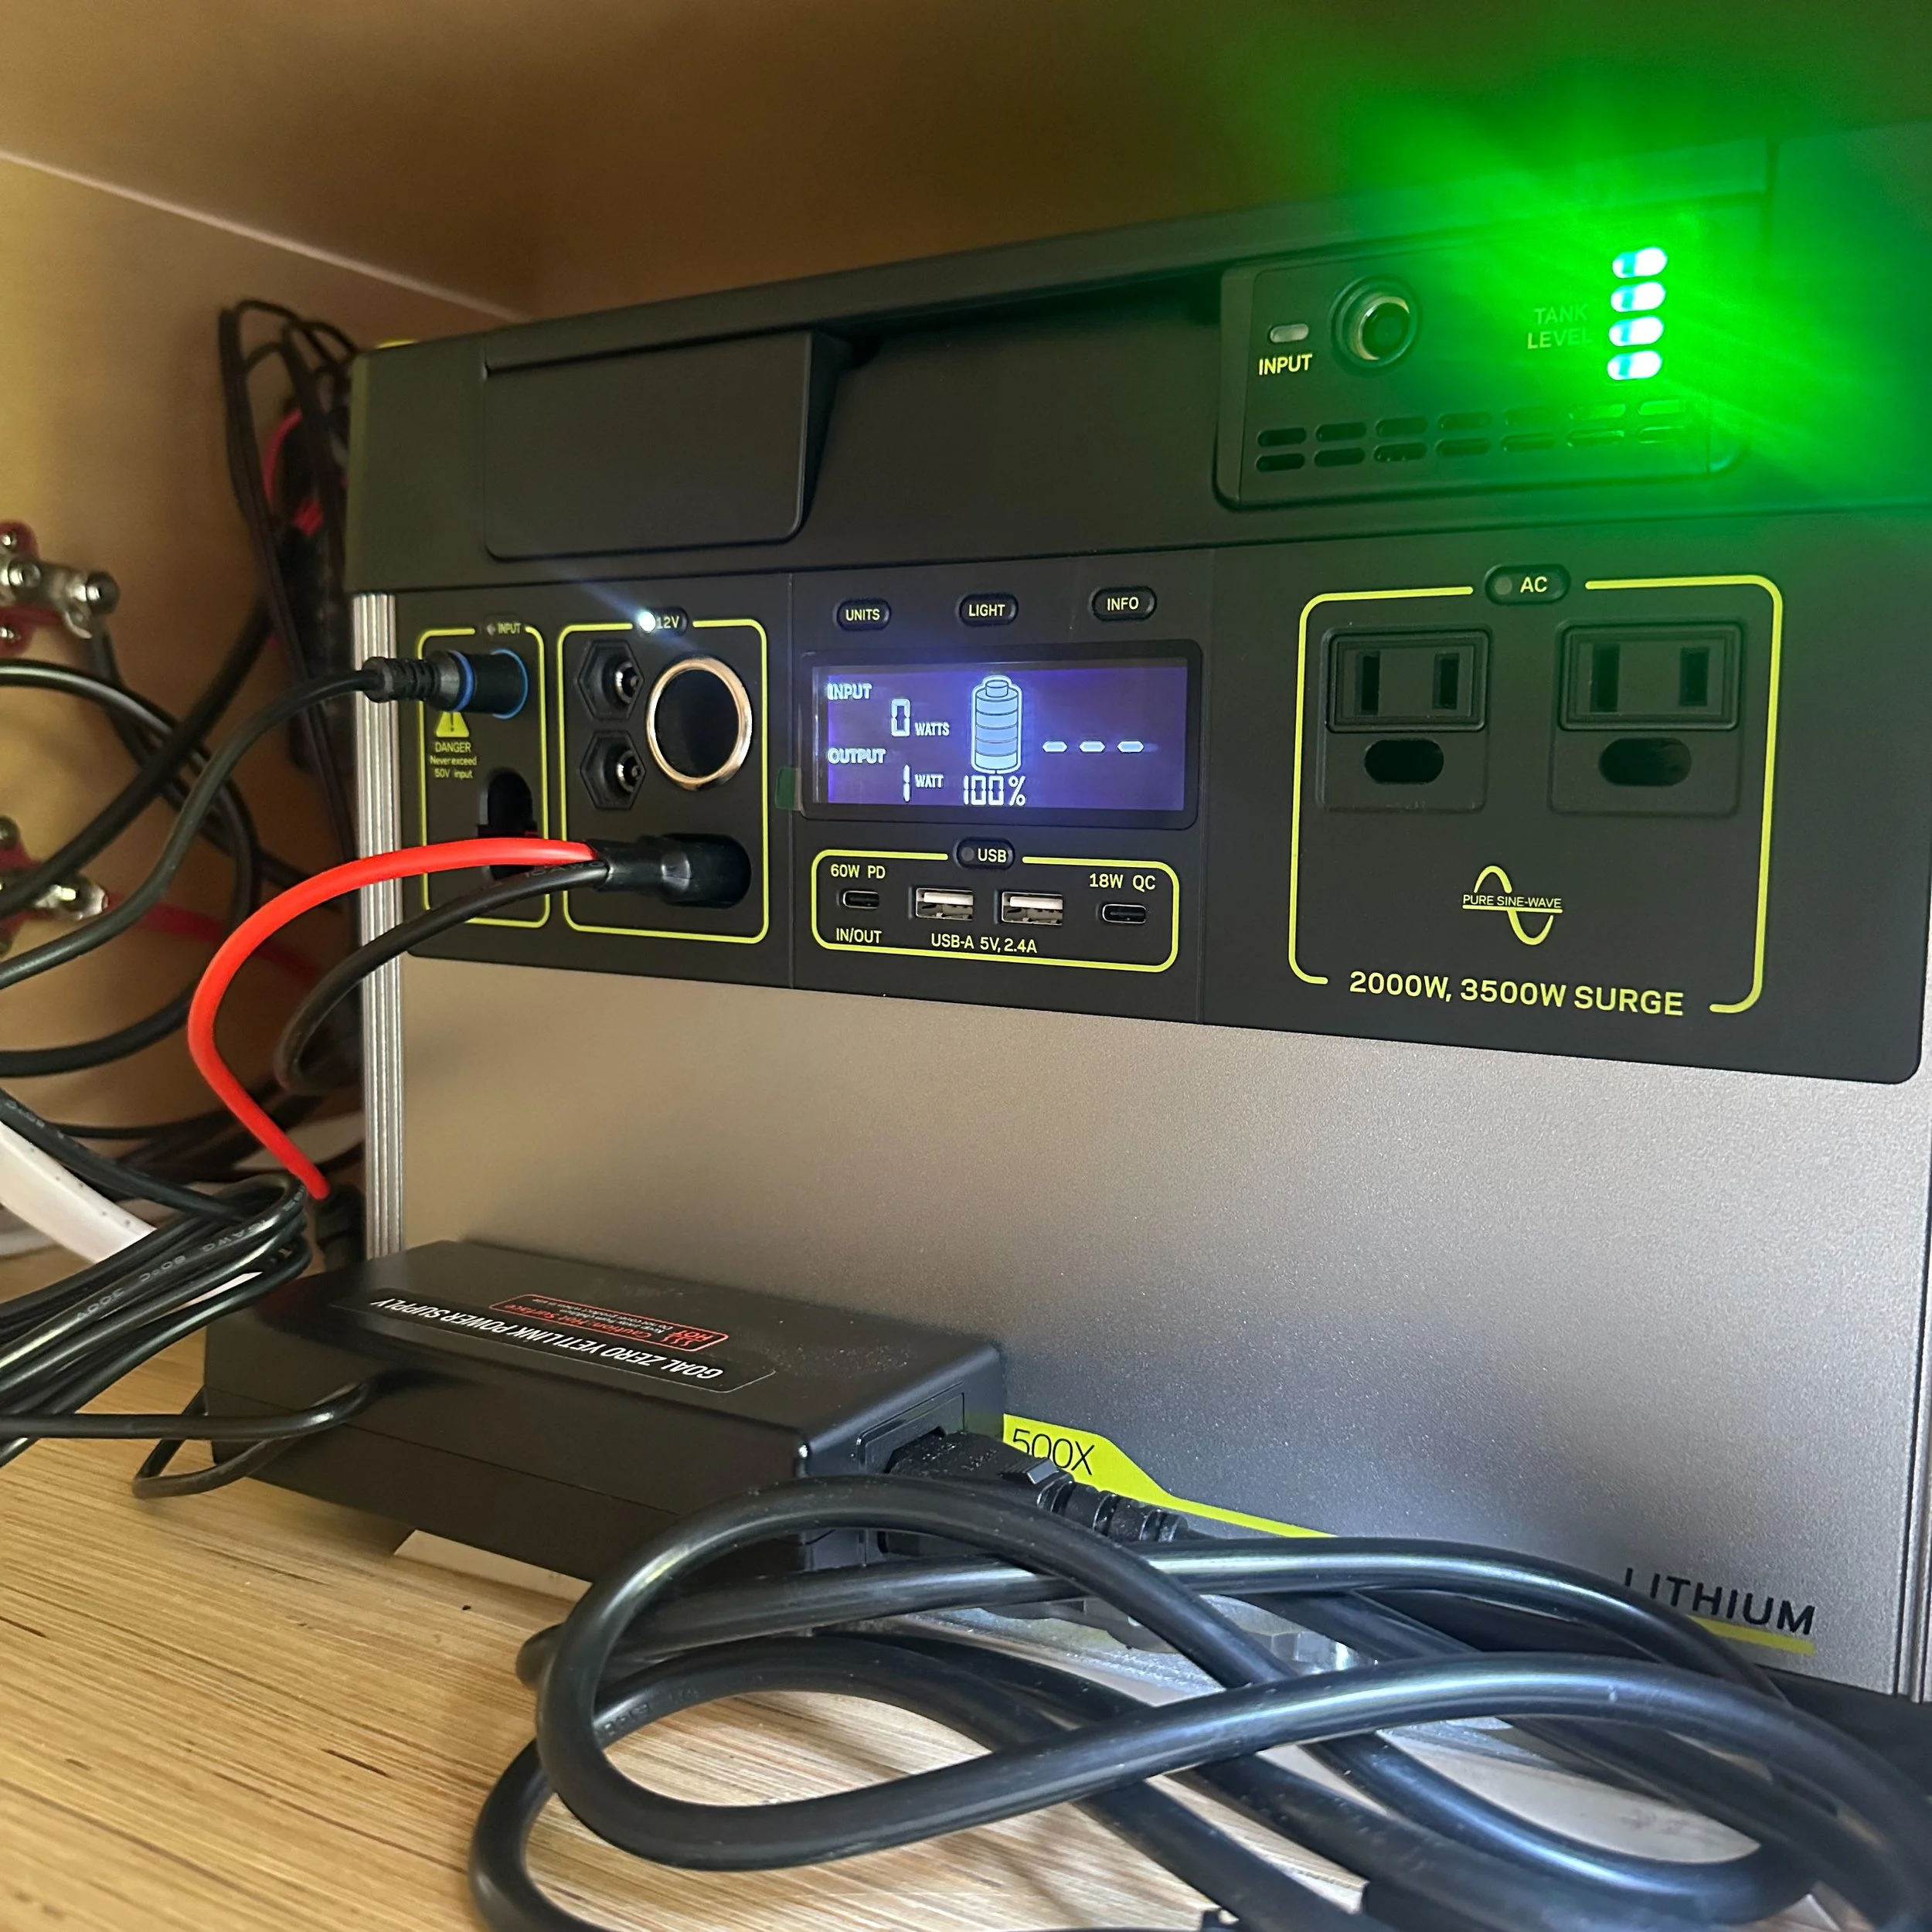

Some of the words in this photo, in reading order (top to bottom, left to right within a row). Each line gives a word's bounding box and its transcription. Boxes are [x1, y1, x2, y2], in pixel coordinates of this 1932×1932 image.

[1533, 303, 1589, 325] TANK
[1527, 326, 1594, 350] LEVEL
[1257, 353, 1313, 376] INPUT
[1519, 576, 1548, 594] AC
[968, 604, 1005, 617] LIGHT
[1107, 597, 1139, 611] INFO
[656, 615, 681, 629] 12V
[845, 608, 881, 622] UNITS
[498, 622, 522, 634] INPUT
[827, 683, 872, 700] INPUT
[891, 699, 910, 736] 0
[914, 722, 950, 736] WATTS
[434, 741, 471, 753] DANGER
[430, 756, 451, 765] Never
[451, 756, 478, 766] exceed
[827, 748, 886, 765] OUTPUT
[434, 768, 451, 778] 50V
[454, 769, 474, 780] input
[903, 764, 910, 803] 1
[914, 774, 944, 789] WATT
[963, 775, 1026, 807] 100%
[978, 848, 1008, 863] USB
[830, 864, 859, 879] 60W
[867, 865, 886, 879] PD
[1089, 872, 1123, 889] 18W
[1132, 874, 1156, 891] QC
[1462, 894, 1494, 906] PURE
[1497, 896, 1562, 908] SINE-WAVE
[835, 927, 883, 945] IN/OUT
[931, 933, 975, 950] USB-A
[1349, 971, 1451, 1003] 2000W,
[1461, 978, 1566, 1008] 3500W
[1574, 987, 1684, 1016] SURGE
[369, 1298, 451, 1318] SUPPLY
[440, 1312, 519, 1334] POWER
[506, 1327, 564, 1344] LINK
[671, 1329, 714, 1342] HOT
[553, 1337, 607, 1354] YETI
[600, 1346, 667, 1367] ZERO
[660, 1359, 724, 1379] GOAL
